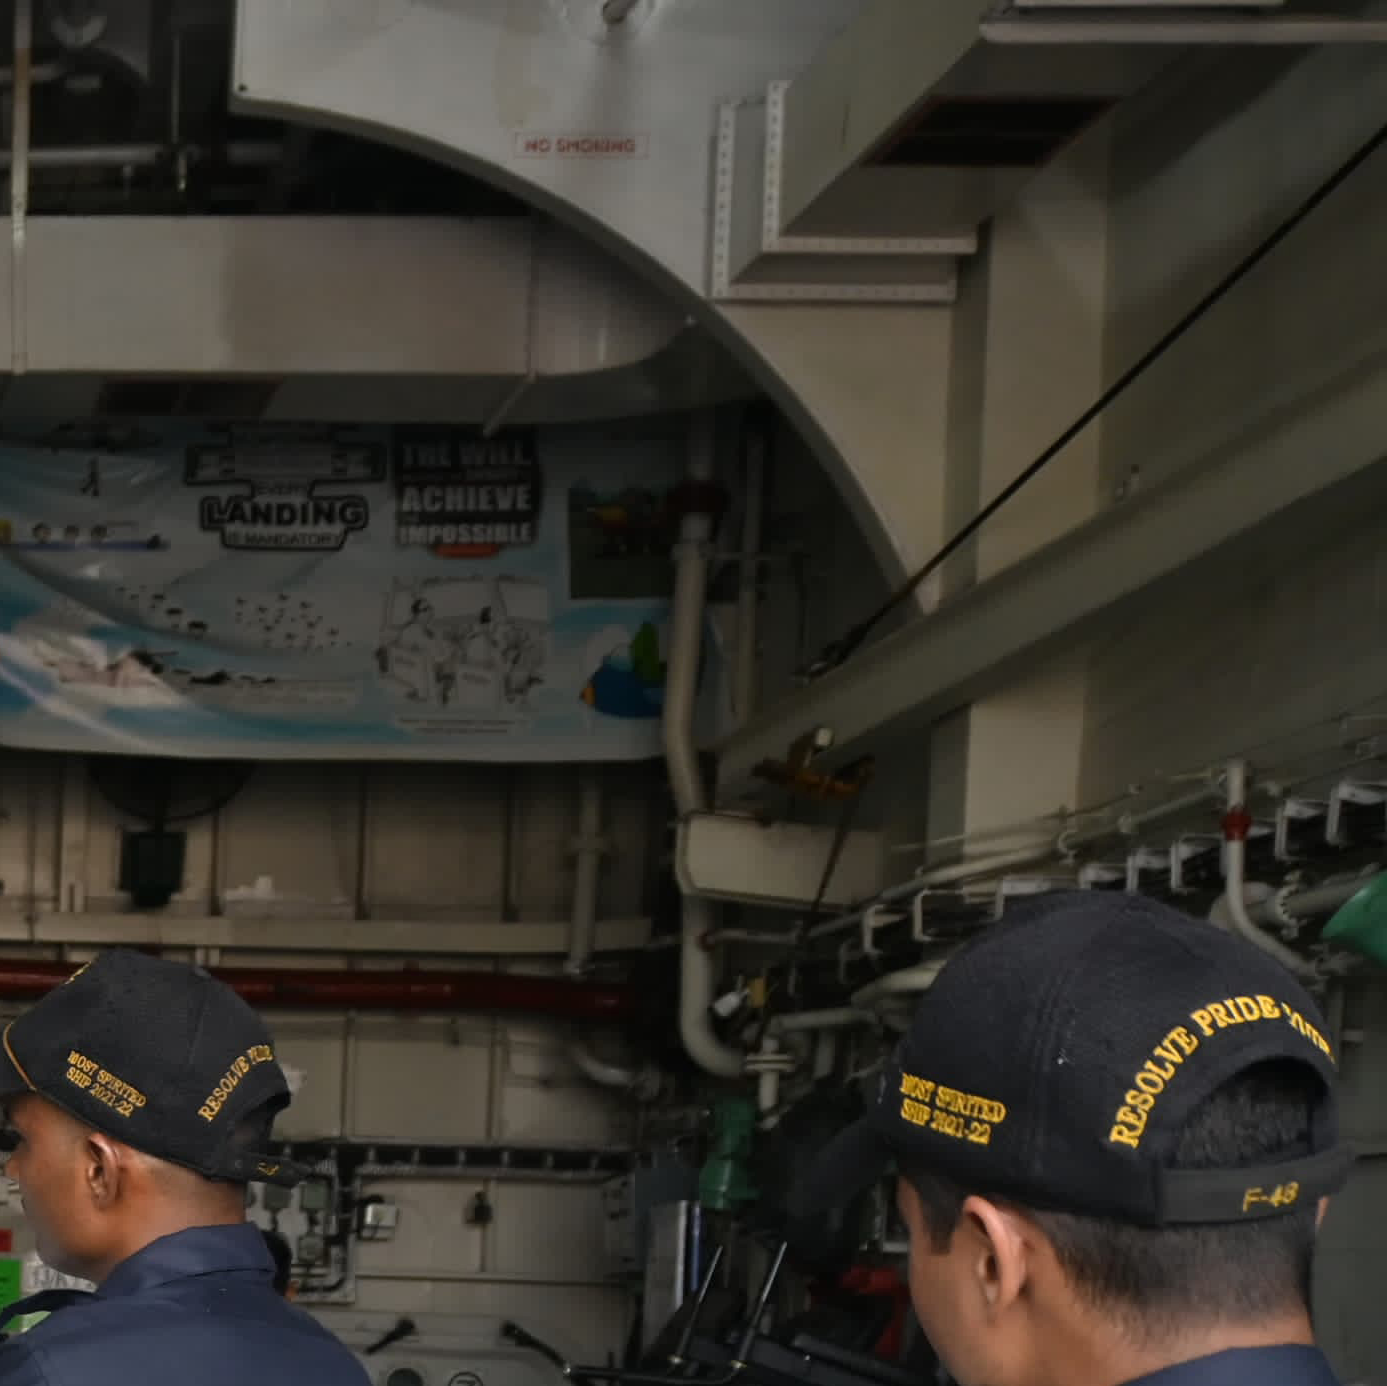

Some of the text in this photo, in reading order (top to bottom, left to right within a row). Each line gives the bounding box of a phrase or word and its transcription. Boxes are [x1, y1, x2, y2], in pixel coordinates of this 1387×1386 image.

[524, 138, 550, 153] NO
[207, 501, 364, 526] LANDING
[402, 486, 532, 513] ACHIEVE
[399, 522, 533, 543] IMPOSSIBLE
[96, 1065, 148, 1109] SPIRITED
[196, 1054, 252, 1123] RESOLVE
[1109, 1025, 1200, 1150] RESOLVE
[1190, 993, 1282, 1037] PRIDE
[89, 1080, 136, 1119] 2021-22
[935, 1085, 1010, 1126] SPIRITED
[929, 1109, 994, 1147] 2021-22
